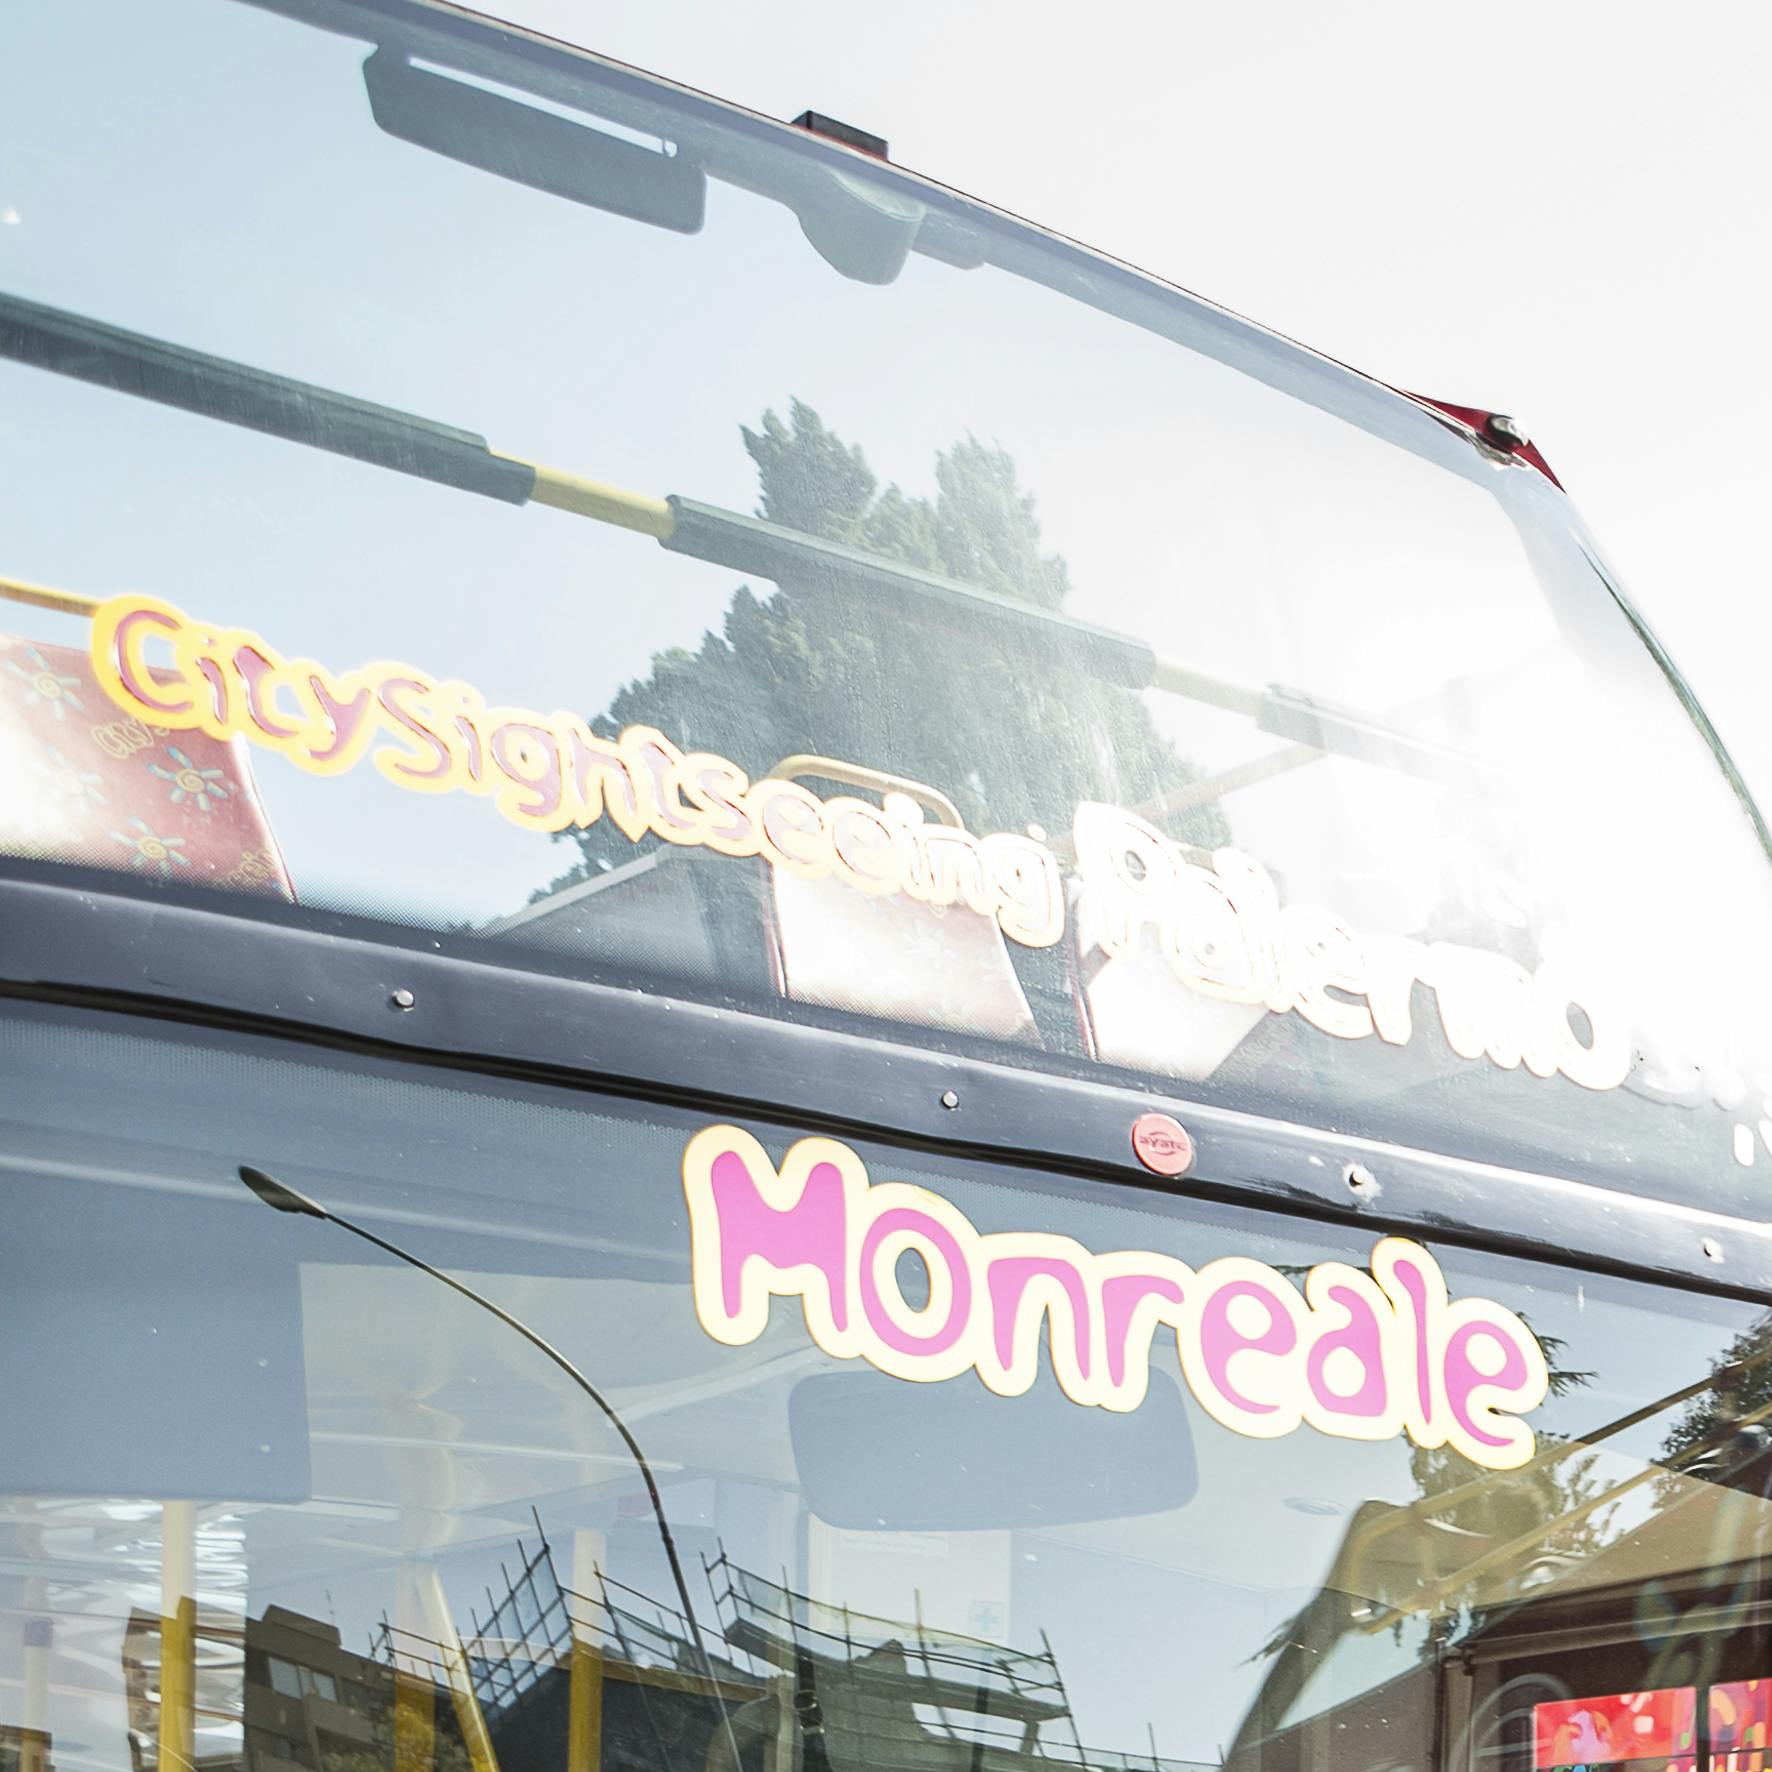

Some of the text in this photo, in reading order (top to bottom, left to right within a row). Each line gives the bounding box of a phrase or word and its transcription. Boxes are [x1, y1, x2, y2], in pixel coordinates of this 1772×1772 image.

[91, 594, 1630, 1091] CitySightseeing Palermo
[682, 1124, 1549, 1470] Monreale
